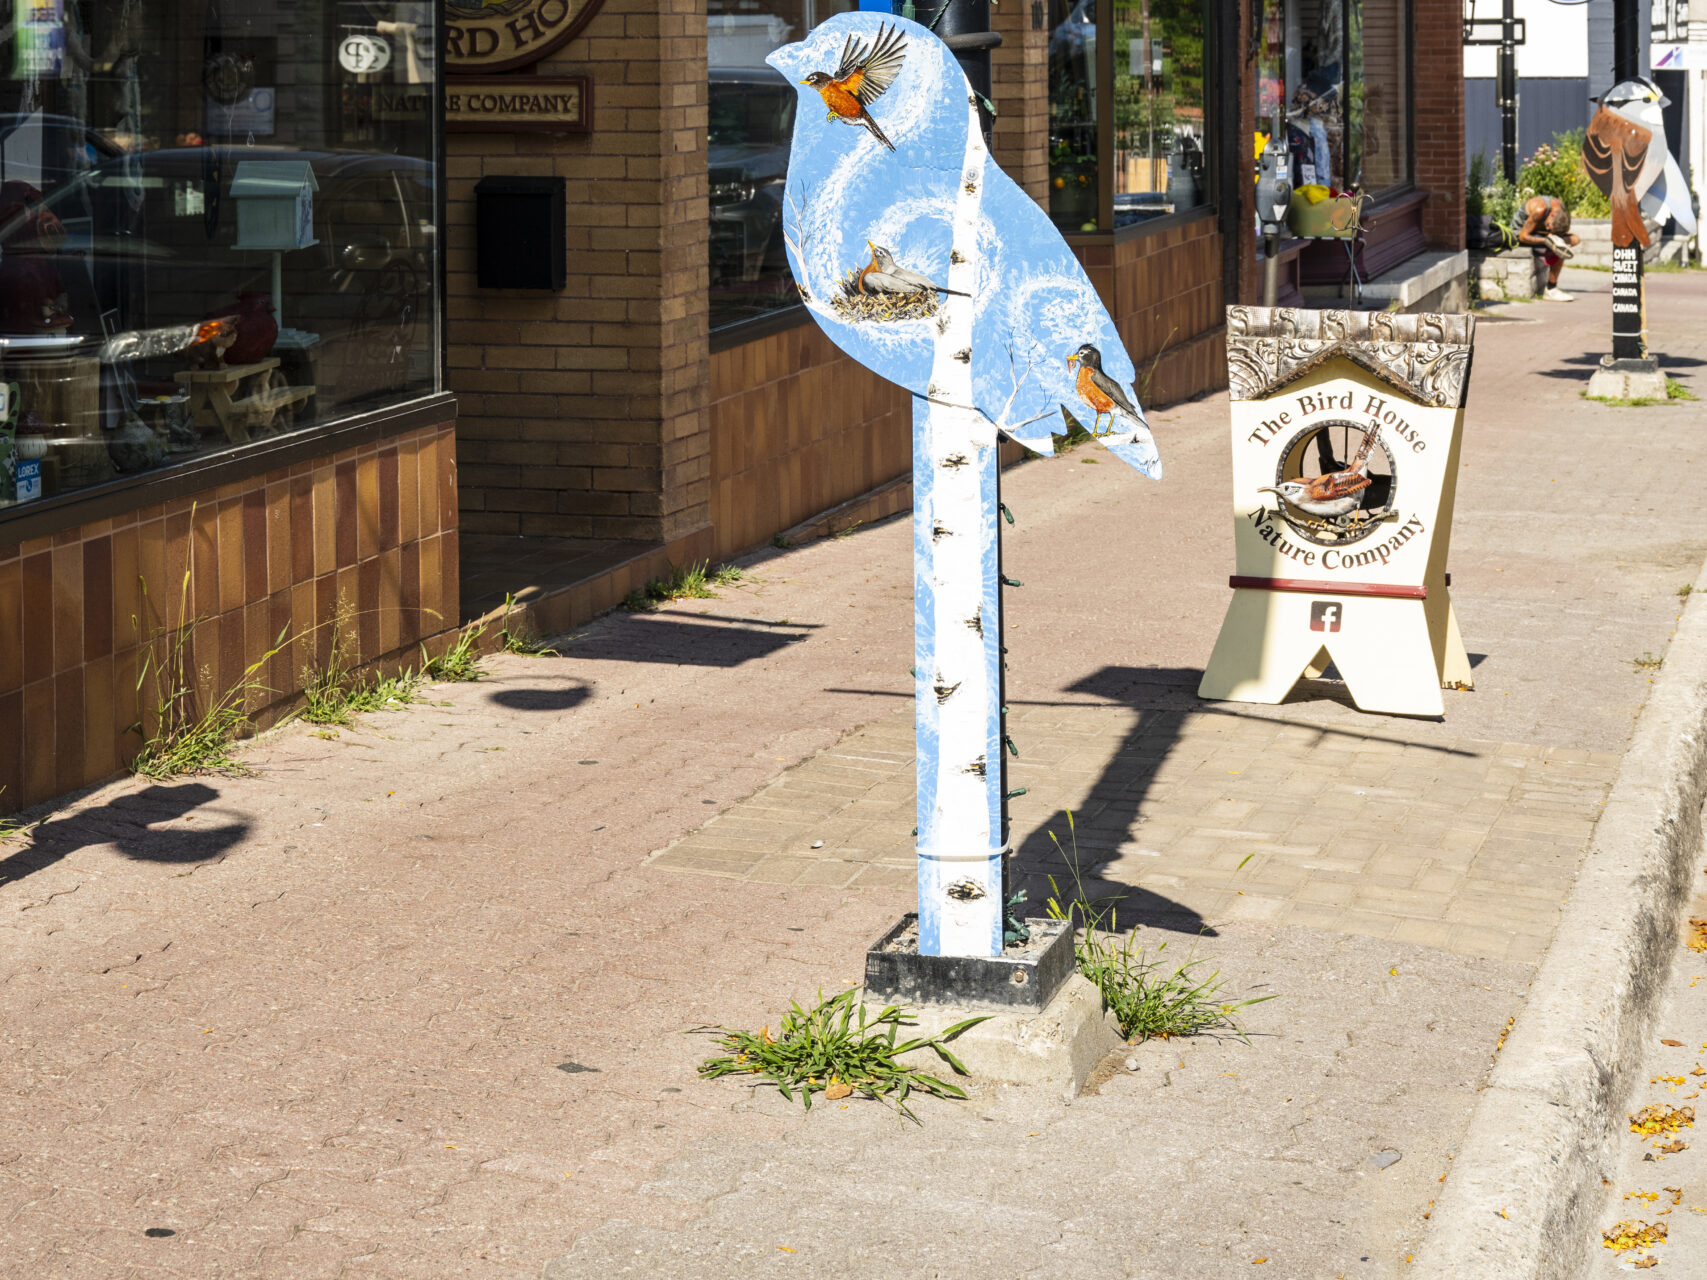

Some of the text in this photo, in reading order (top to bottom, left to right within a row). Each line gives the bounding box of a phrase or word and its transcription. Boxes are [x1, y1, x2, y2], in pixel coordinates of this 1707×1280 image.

[467, 94, 573, 113] COMPANY
[1614, 249, 1636, 260] OHH
[1612, 273, 1638, 283] CANADA
[1612, 288, 1638, 296] CANADA
[1612, 303, 1638, 313] CANADA
[1248, 391, 1427, 454] The Bird House
[18, 463, 39, 478] LOREX
[1247, 504, 1426, 571] Nature Company
